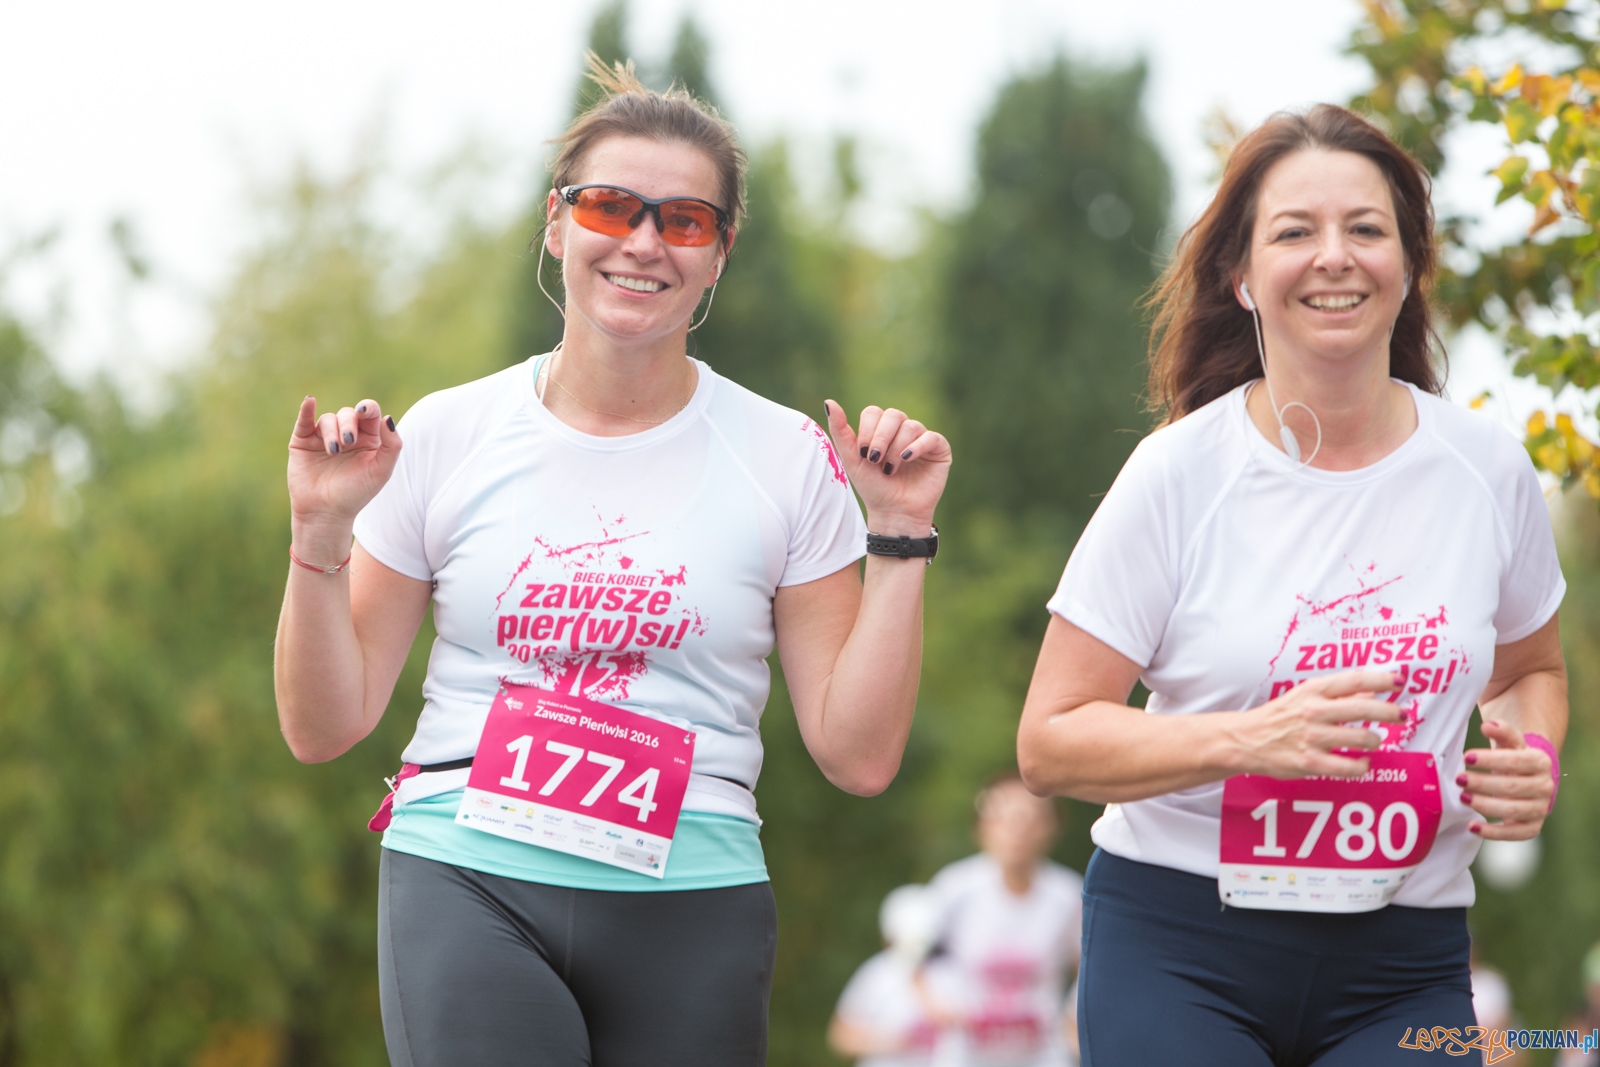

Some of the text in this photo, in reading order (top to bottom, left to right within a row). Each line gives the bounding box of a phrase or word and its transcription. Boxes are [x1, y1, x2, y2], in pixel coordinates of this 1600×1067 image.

[573, 571, 657, 587] BIEG KOBIET
[519, 583, 672, 616] zawsze
[497, 611, 690, 652] pier(w)si!
[1341, 622, 1420, 640] BIEG KOBIET
[1295, 634, 1439, 672] zawsze
[533, 705, 577, 726] Zawsze
[579, 716, 628, 740] Pier(w)si
[629, 729, 660, 748] 2016
[499, 734, 661, 823] 1774
[1376, 769, 1408, 783] 2016
[1249, 798, 1420, 862] 1780
